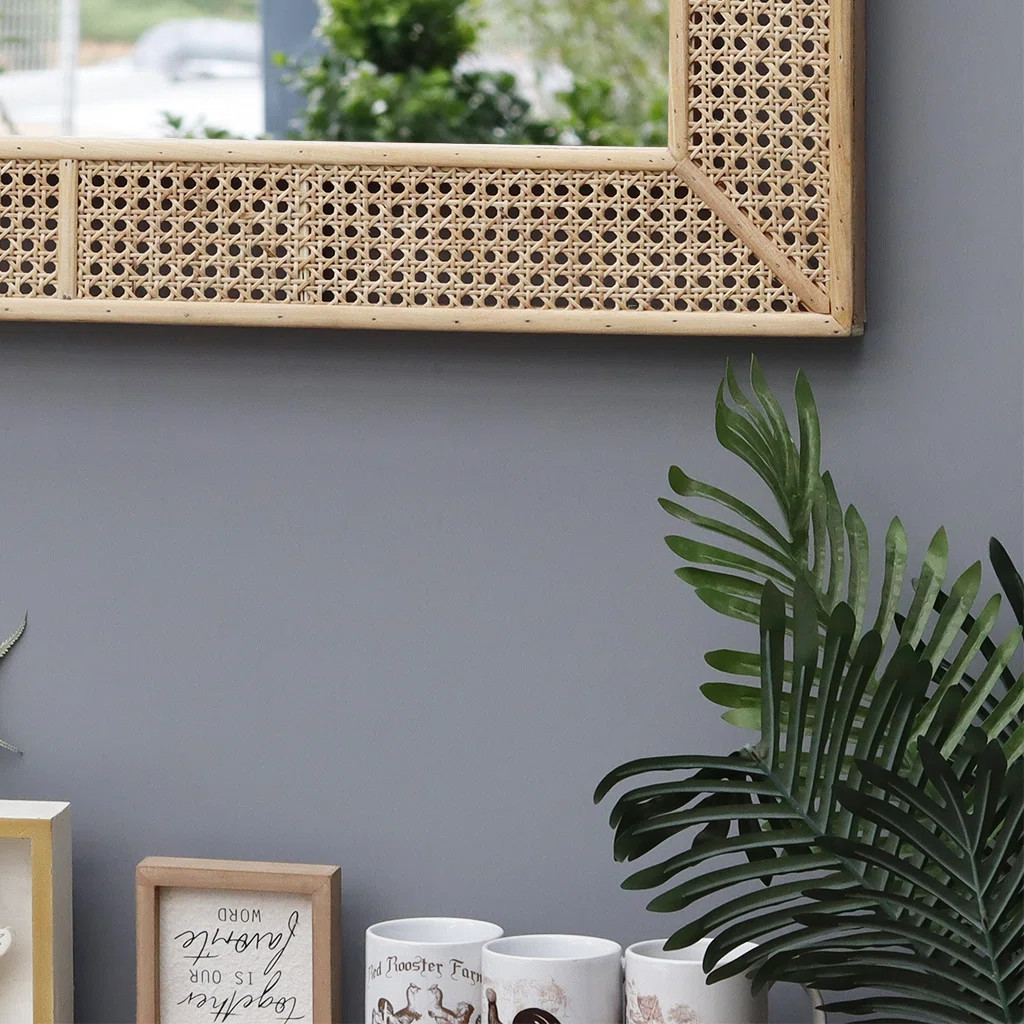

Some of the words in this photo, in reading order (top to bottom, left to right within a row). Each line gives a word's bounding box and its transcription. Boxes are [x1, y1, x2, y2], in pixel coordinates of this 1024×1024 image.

[217, 907, 262, 923] WORD
[173, 910, 300, 976] favorite
[385, 955, 444, 979] Rooster
[189, 968, 223, 985] OUR
[234, 970, 254, 986] IS
